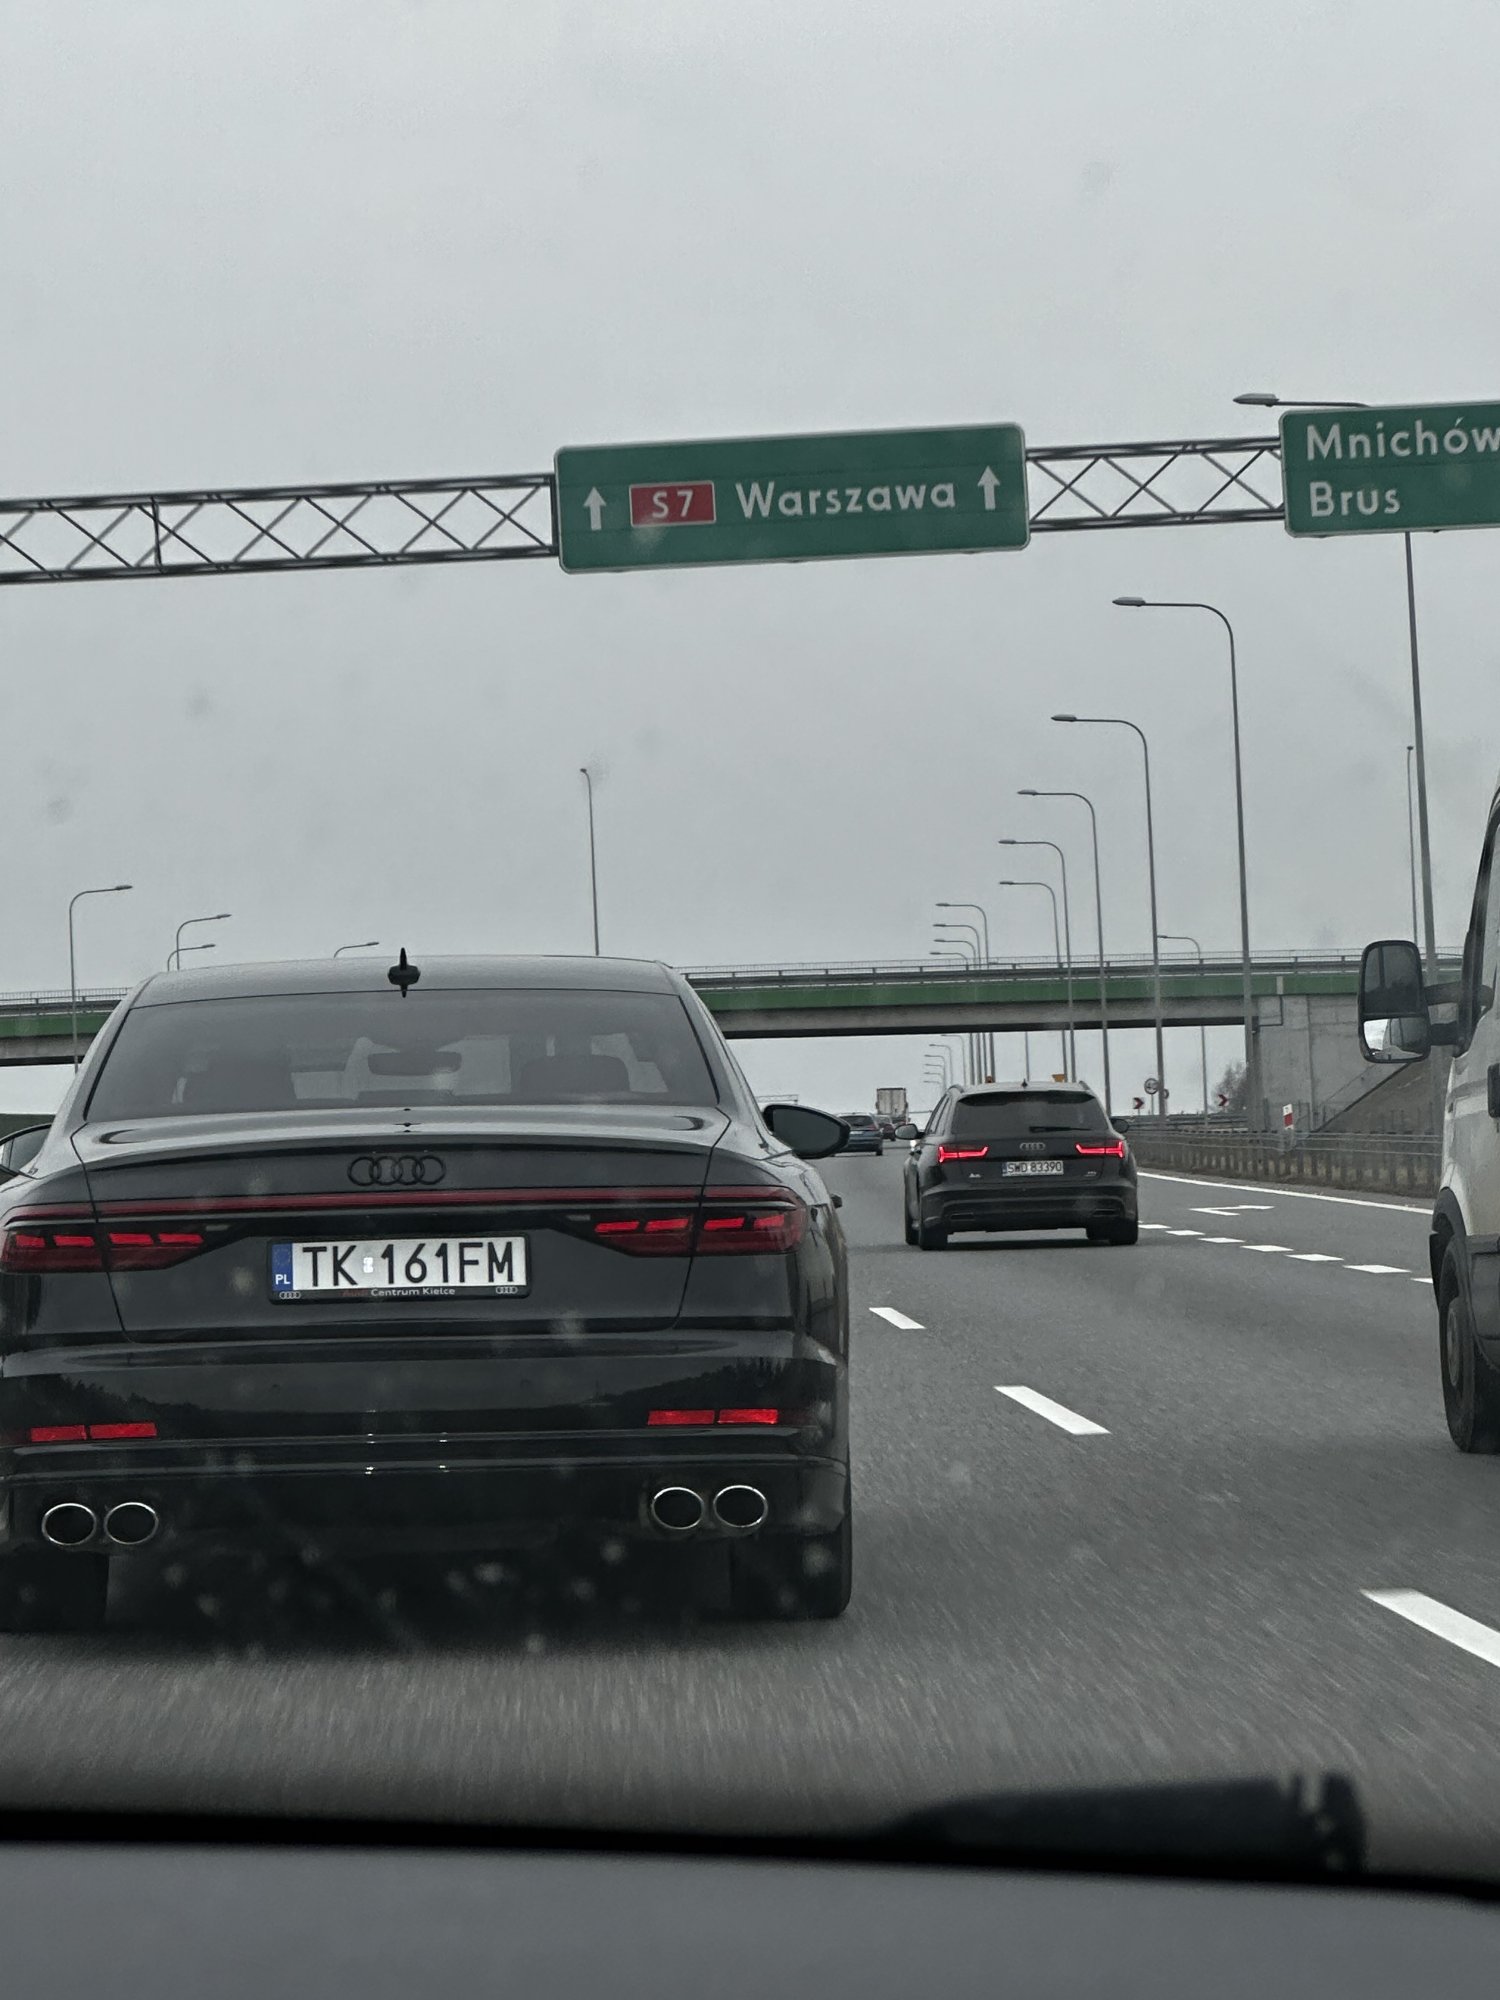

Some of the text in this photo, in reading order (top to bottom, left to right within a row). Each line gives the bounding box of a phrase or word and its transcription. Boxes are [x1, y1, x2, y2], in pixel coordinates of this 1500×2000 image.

[1306, 416, 1500, 461] Mnichów
[652, 480, 955, 519] S7 Warszawa
[1309, 481, 1401, 517] Brus
[275, 1273, 291, 1285] PL
[302, 1241, 514, 1287] TK 161FM
[370, 1288, 420, 1297] Centrum
[422, 1287, 456, 1296] Kielce
